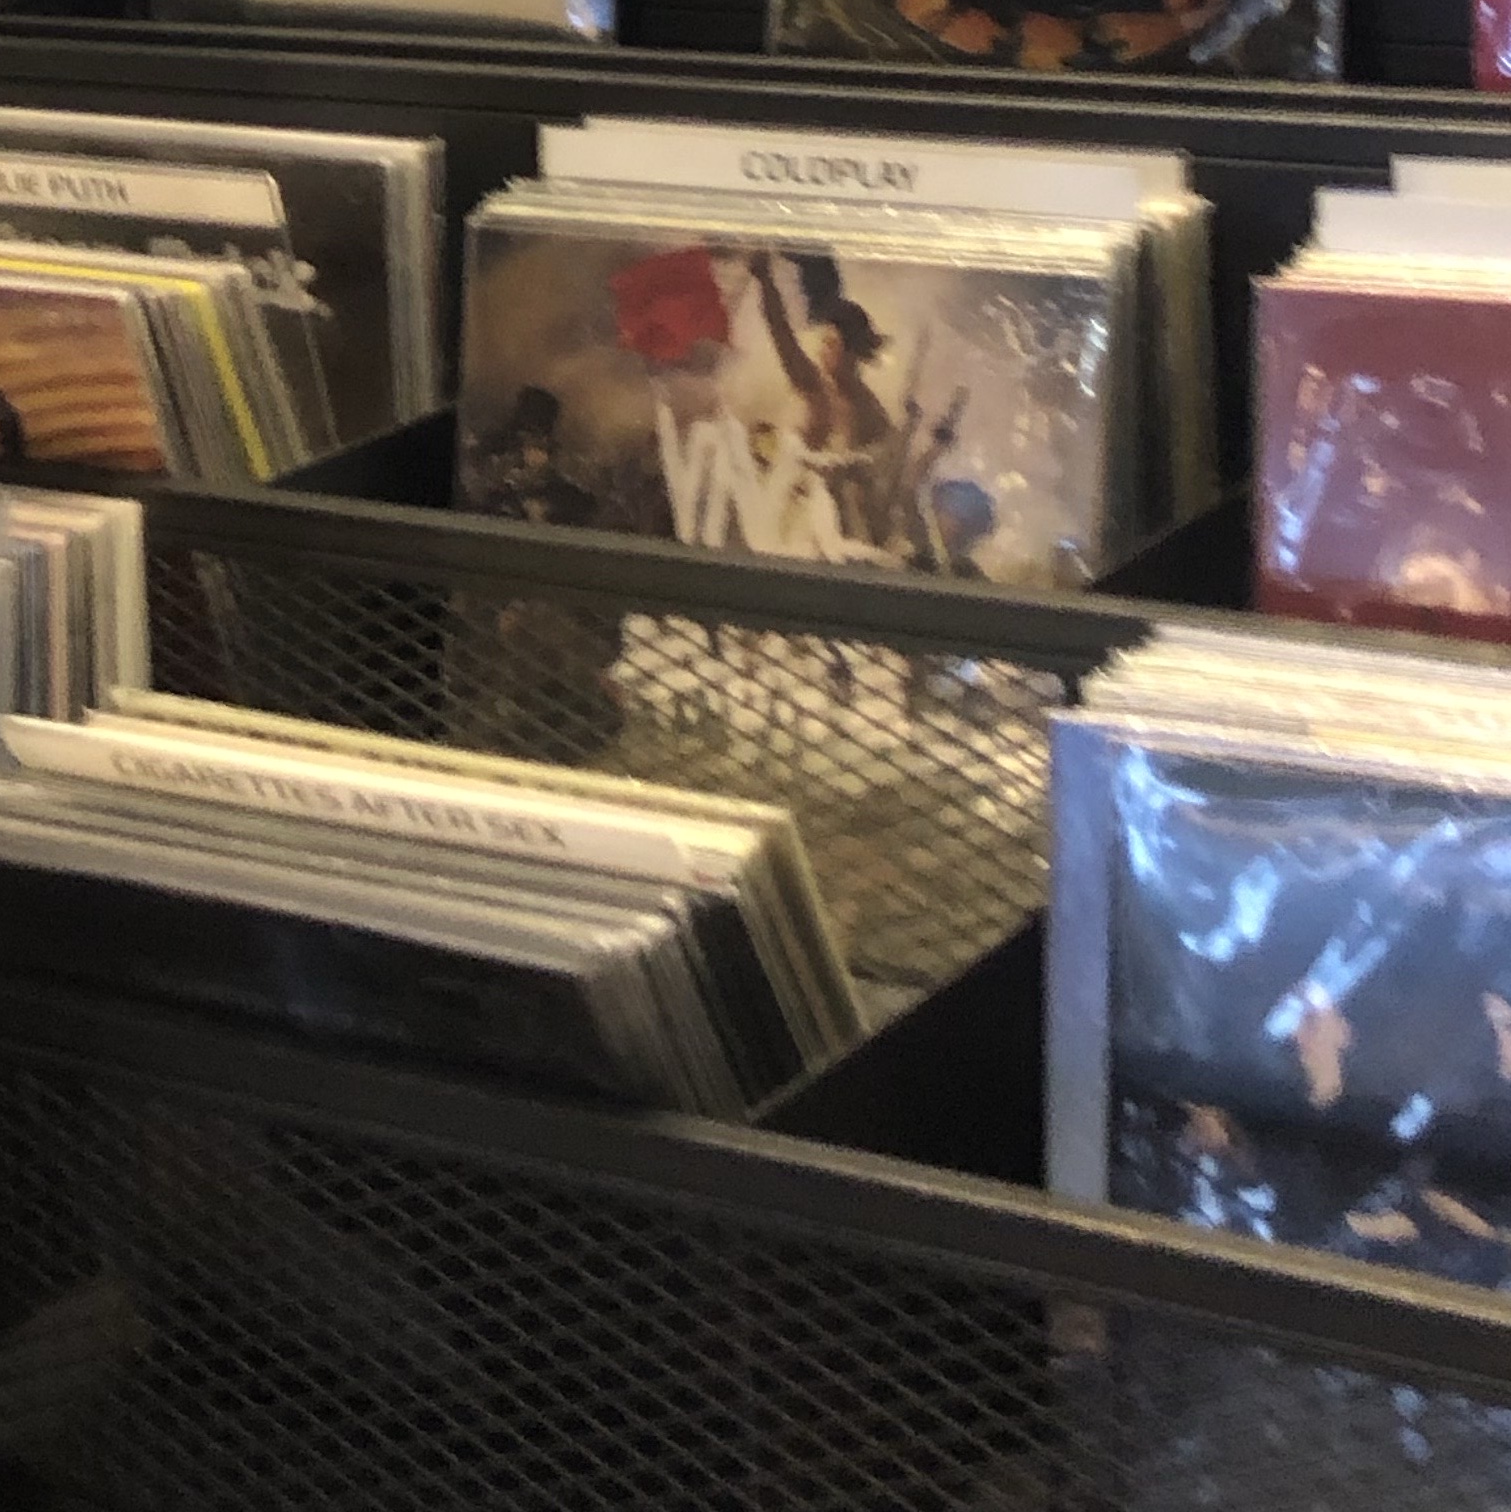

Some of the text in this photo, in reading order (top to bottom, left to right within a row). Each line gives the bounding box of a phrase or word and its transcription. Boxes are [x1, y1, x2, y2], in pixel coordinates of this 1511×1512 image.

[45, 172, 129, 206] PUTH
[740, 149, 919, 192] COLDPLAY
[108, 747, 567, 848] CIGARETTES AFTER SEX
